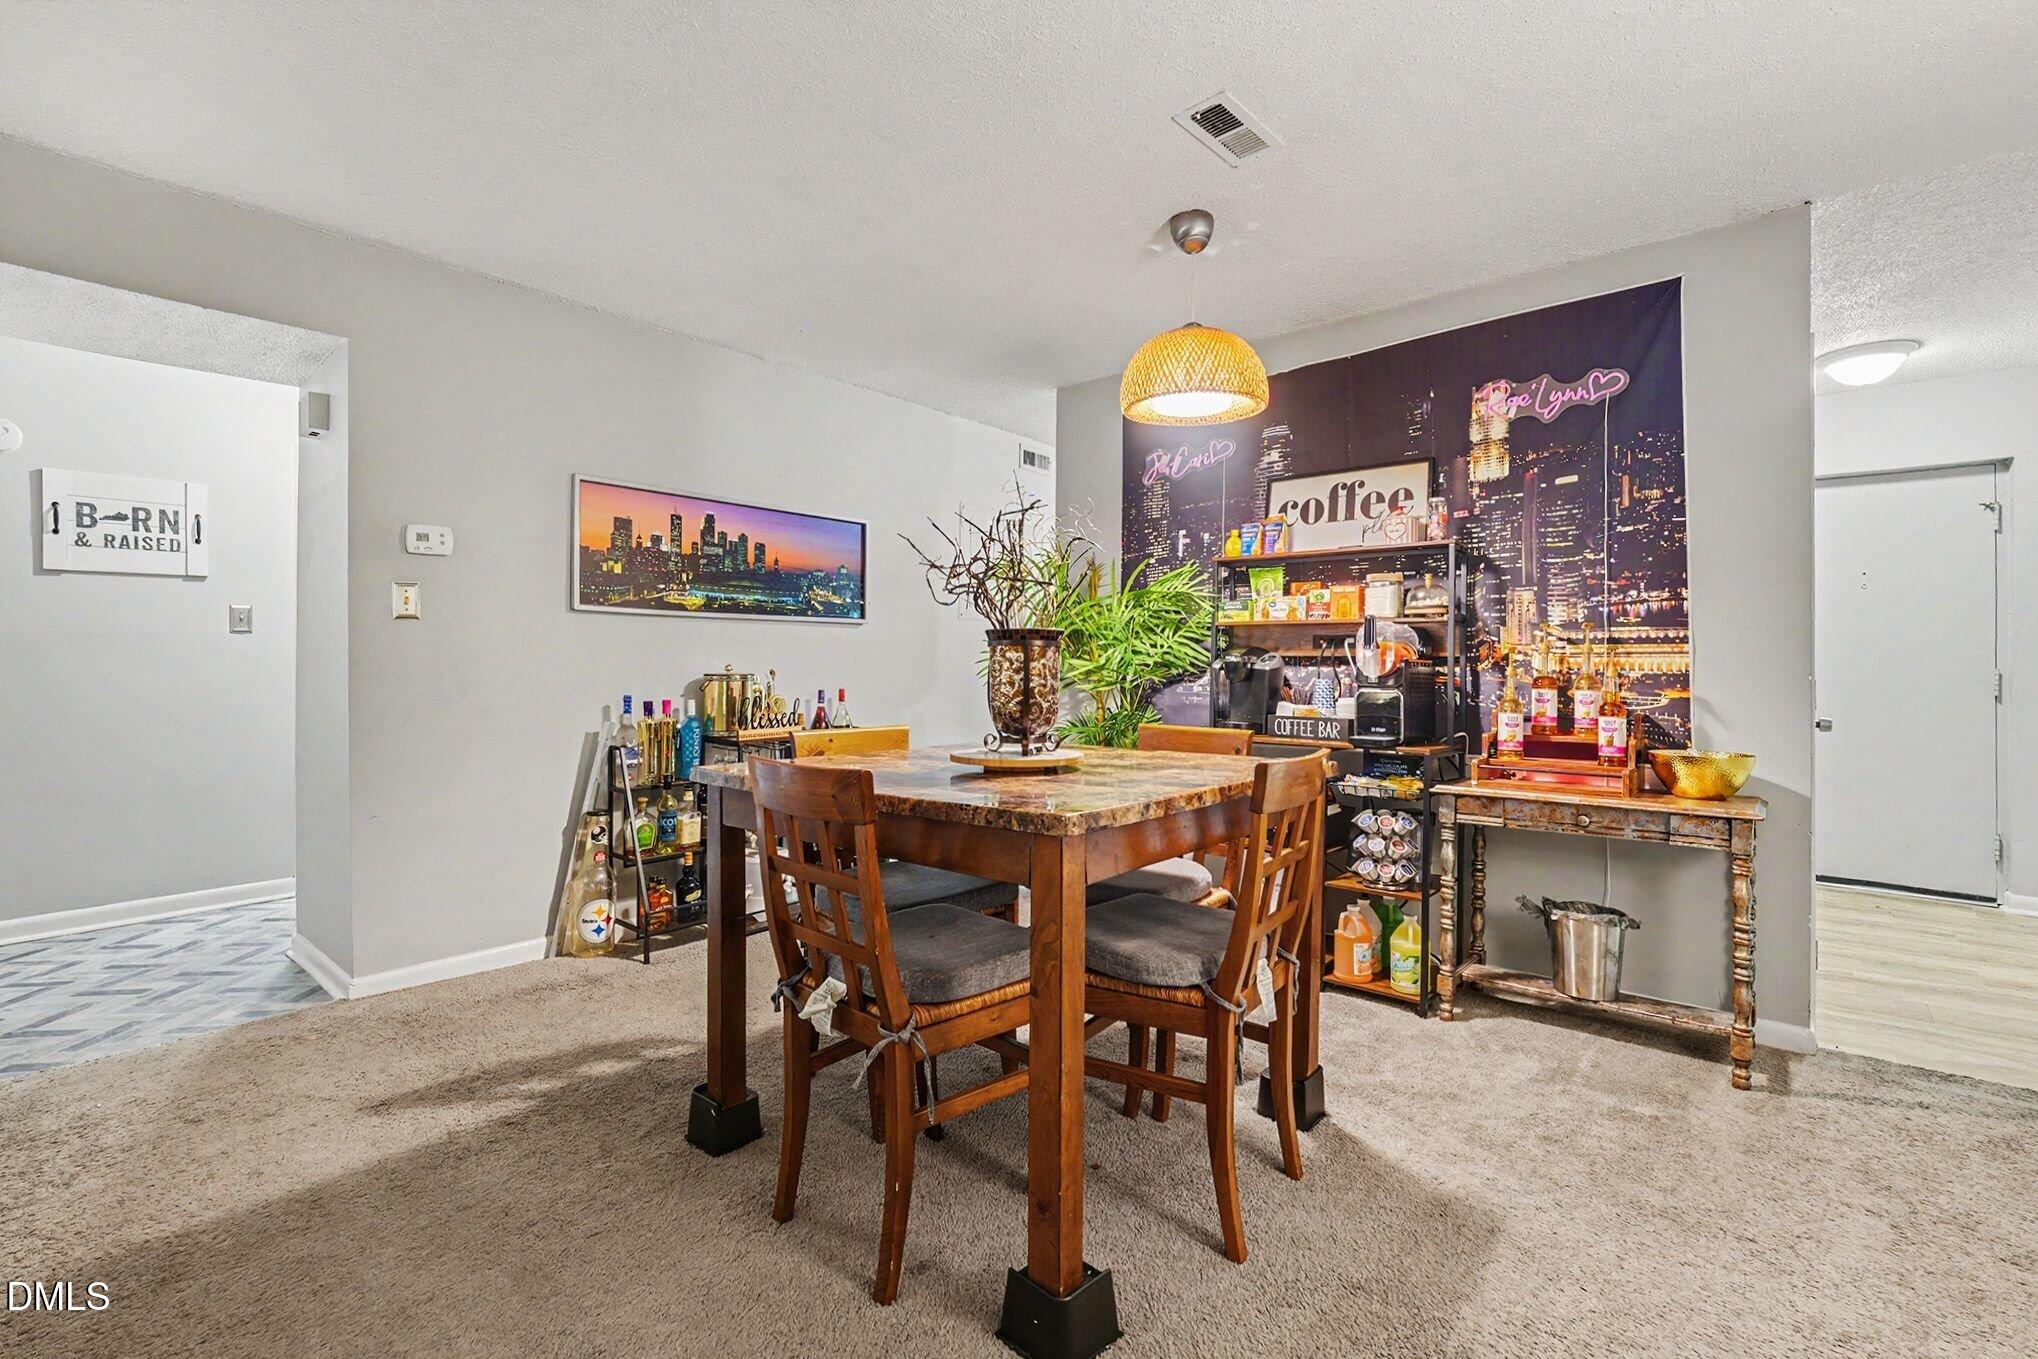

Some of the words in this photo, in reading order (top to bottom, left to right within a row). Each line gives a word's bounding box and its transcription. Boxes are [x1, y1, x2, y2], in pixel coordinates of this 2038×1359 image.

[1278, 480, 1414, 526] coffee
[75, 532, 92, 547] &
[104, 533, 181, 552] RAISED
[738, 695, 799, 730] blessed
[1275, 718, 1314, 737] COFFEE
[1318, 721, 1341, 739] BAR
